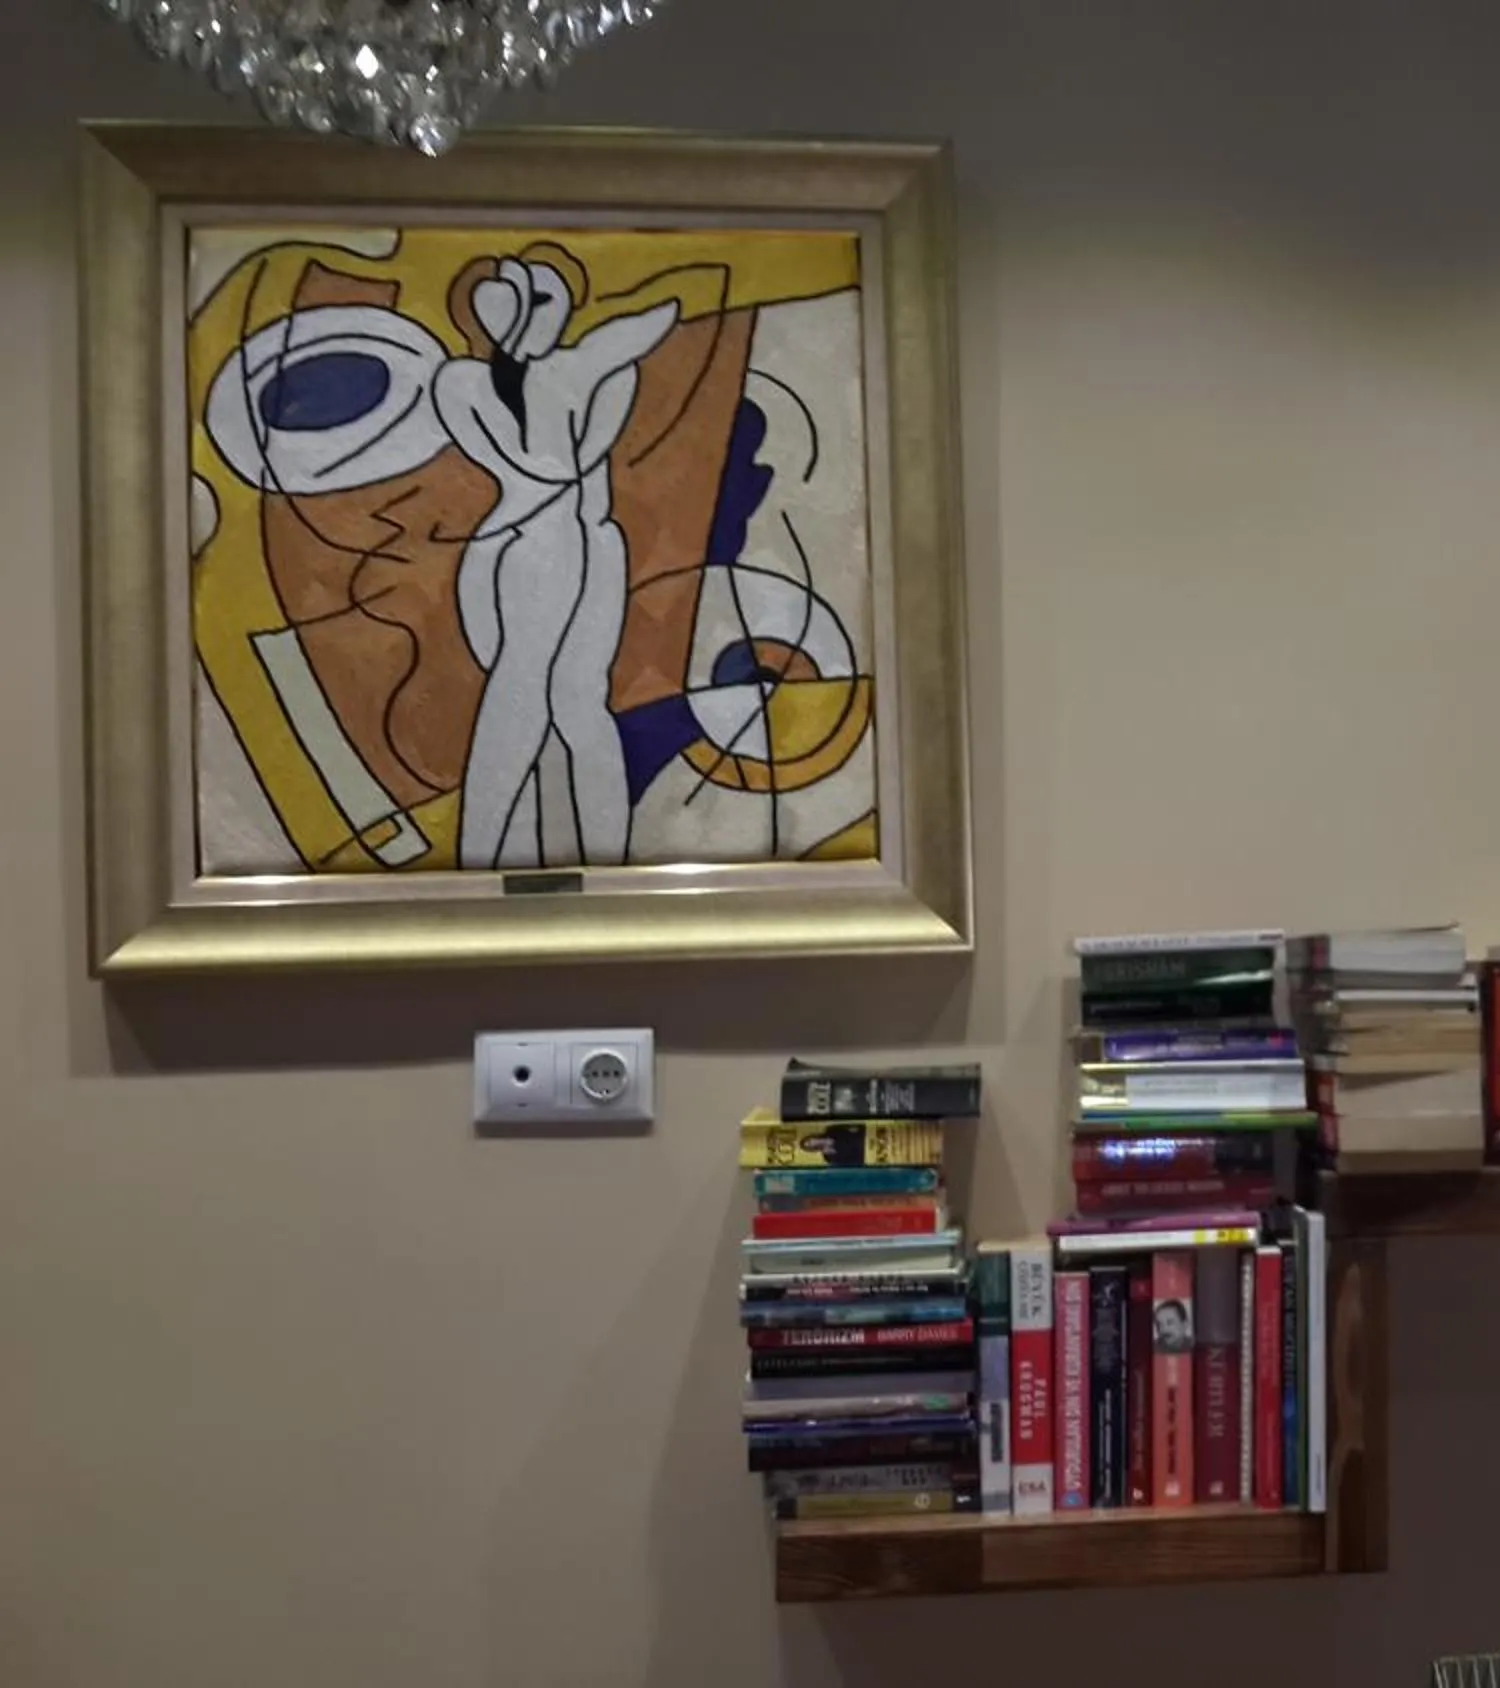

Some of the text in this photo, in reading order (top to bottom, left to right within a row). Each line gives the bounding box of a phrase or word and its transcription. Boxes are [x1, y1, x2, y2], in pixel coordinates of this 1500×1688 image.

[1031, 1263, 1042, 1315] BÜYÜK
[1020, 1360, 1033, 1440] KRUGMAN
[1034, 1379, 1047, 1418] PAUL
